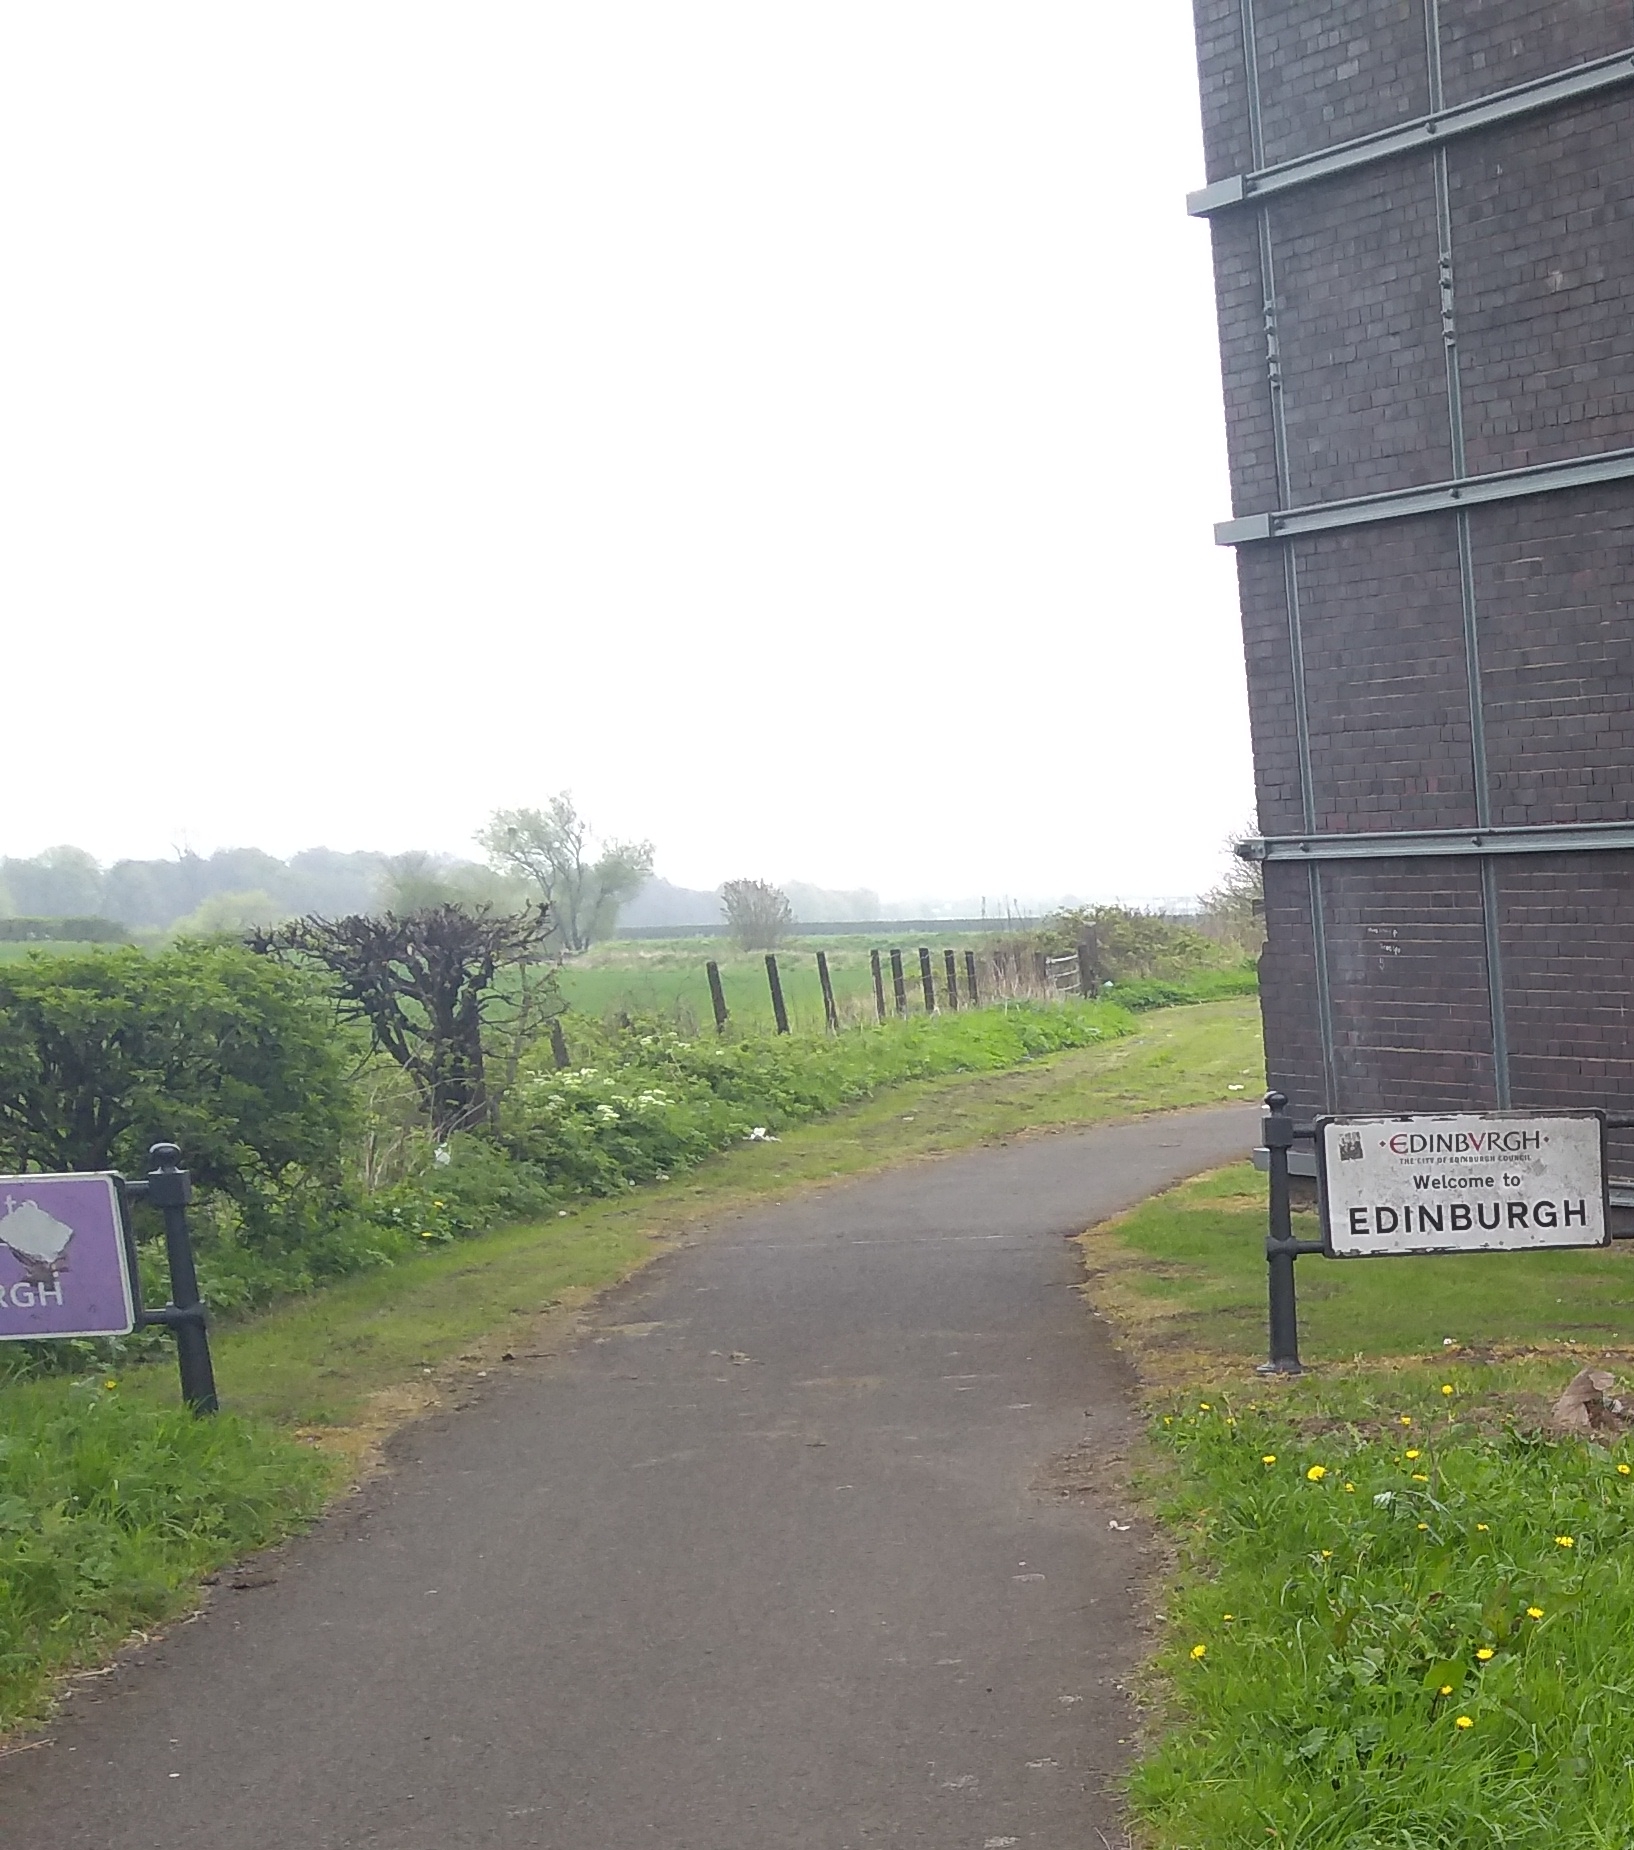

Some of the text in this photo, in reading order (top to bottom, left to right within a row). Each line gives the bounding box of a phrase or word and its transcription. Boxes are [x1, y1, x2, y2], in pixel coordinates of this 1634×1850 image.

[1437, 1156, 1447, 1164] OF
[1497, 1154, 1532, 1162] COUNCIL
[1413, 1173, 1521, 1190] Welcome to
[1348, 1199, 1587, 1236] EDINBURGH
